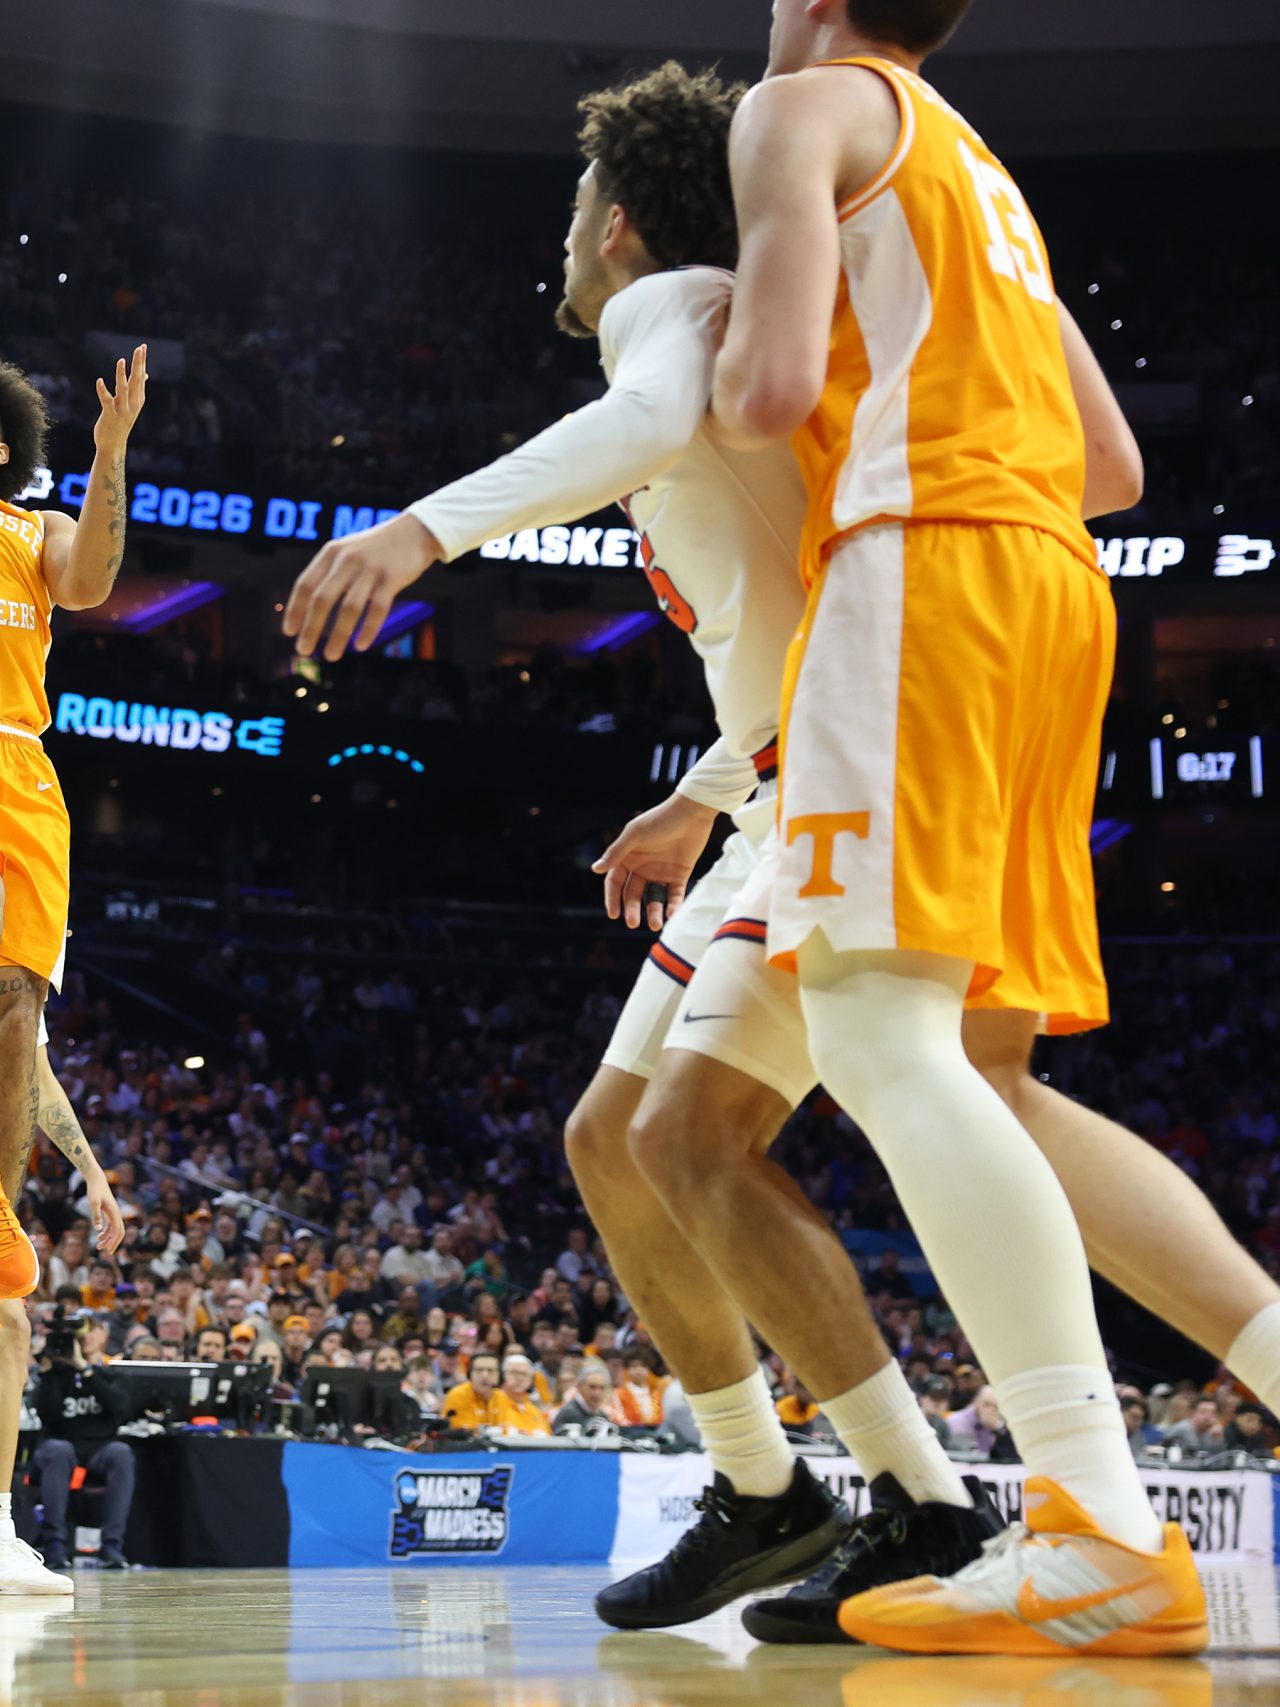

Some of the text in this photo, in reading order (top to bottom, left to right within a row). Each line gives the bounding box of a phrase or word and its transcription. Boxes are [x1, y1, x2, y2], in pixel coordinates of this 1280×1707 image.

[130, 482, 254, 534] 2026
[263, 497, 323, 541] DI
[55, 692, 234, 753] ROUNDS
[785, 810, 870, 899] T
[416, 1475, 482, 1508] MARCH
[424, 1507, 506, 1542] MADNESS
